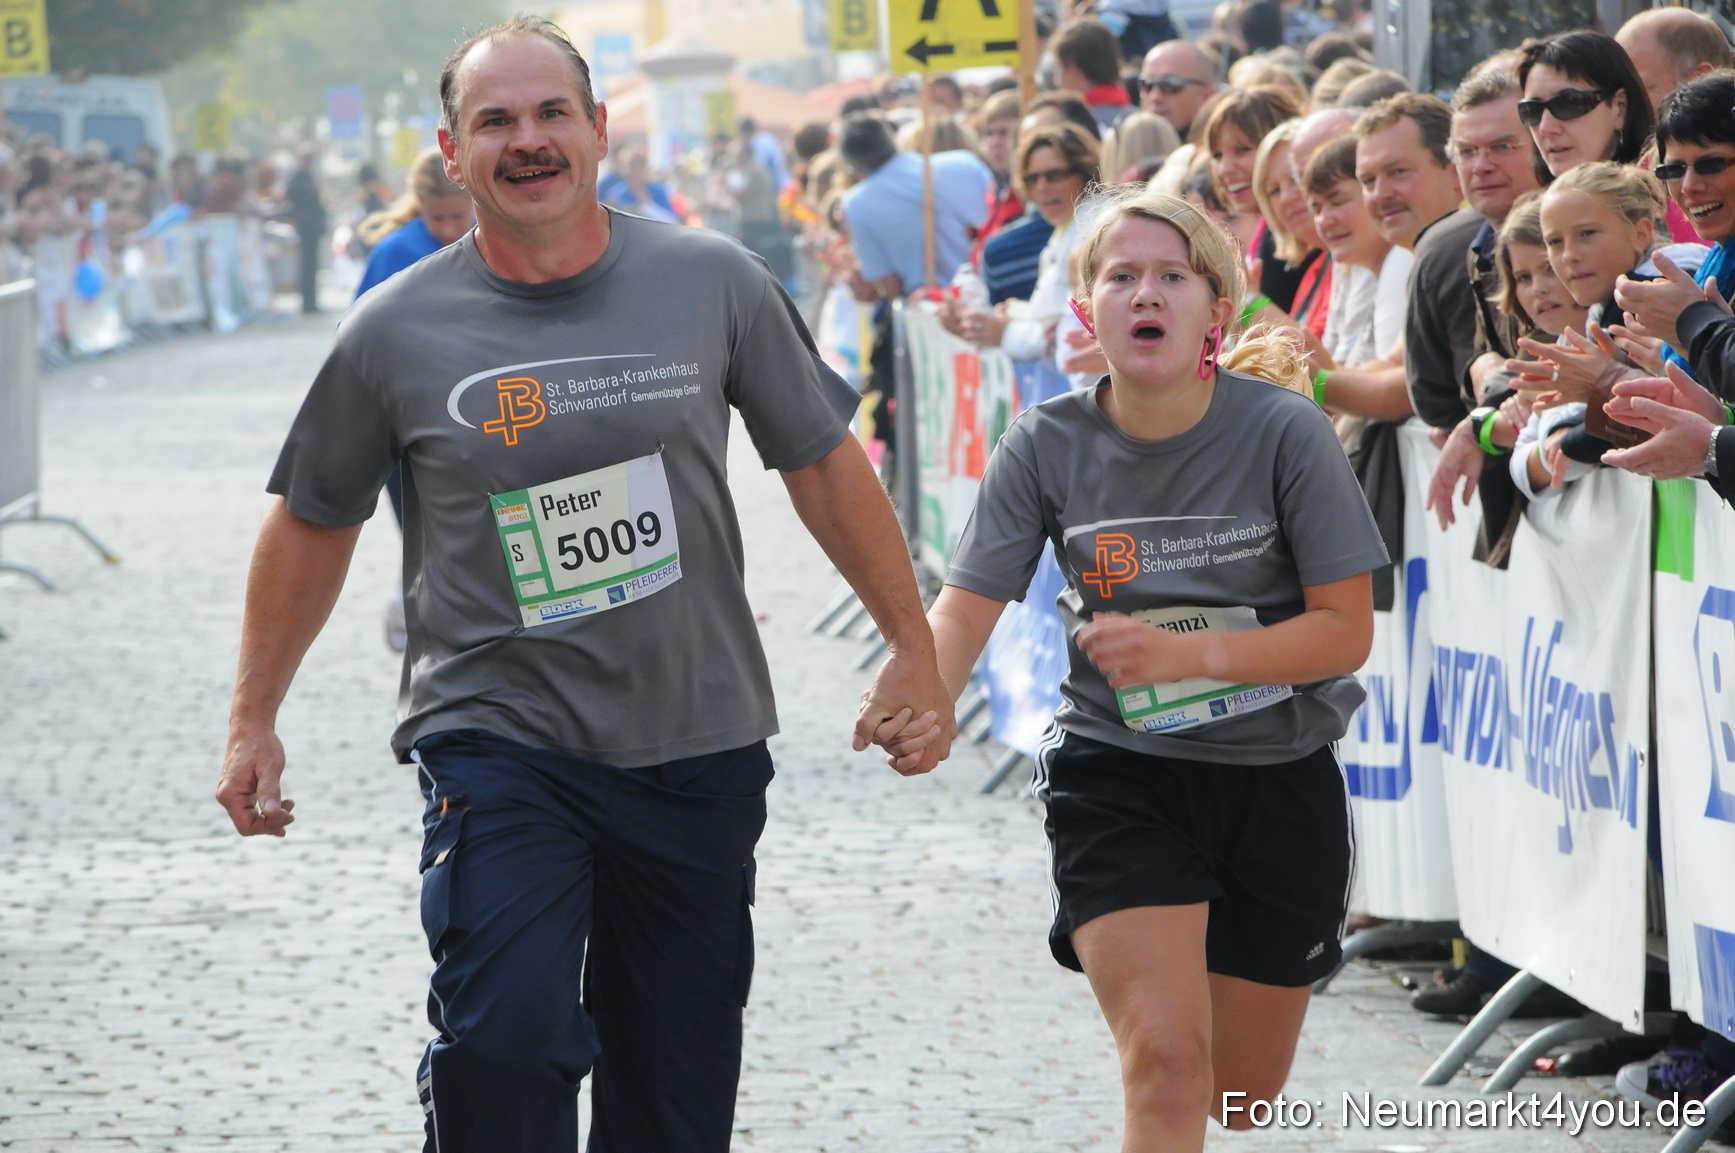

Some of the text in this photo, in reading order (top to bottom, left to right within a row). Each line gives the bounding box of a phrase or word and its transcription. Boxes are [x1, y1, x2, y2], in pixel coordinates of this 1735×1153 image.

[5, 19, 32, 58] B
[546, 361, 699, 398] St. Barbara-Krankenhaus
[549, 383, 701, 416] Schwandorf Gemeinnützige GmbH
[539, 489, 602, 521] Peter
[511, 544, 525, 562] S
[557, 511, 662, 571] 5009
[1141, 520, 1279, 556] St. Barbara-Krankenhaus
[1142, 550, 1210, 573] Schwandorf
[1212, 546, 1264, 565] Gemeinnützige
[625, 561, 679, 592] PFLEIDERER
[1227, 684, 1289, 707] PFLEIDERER
